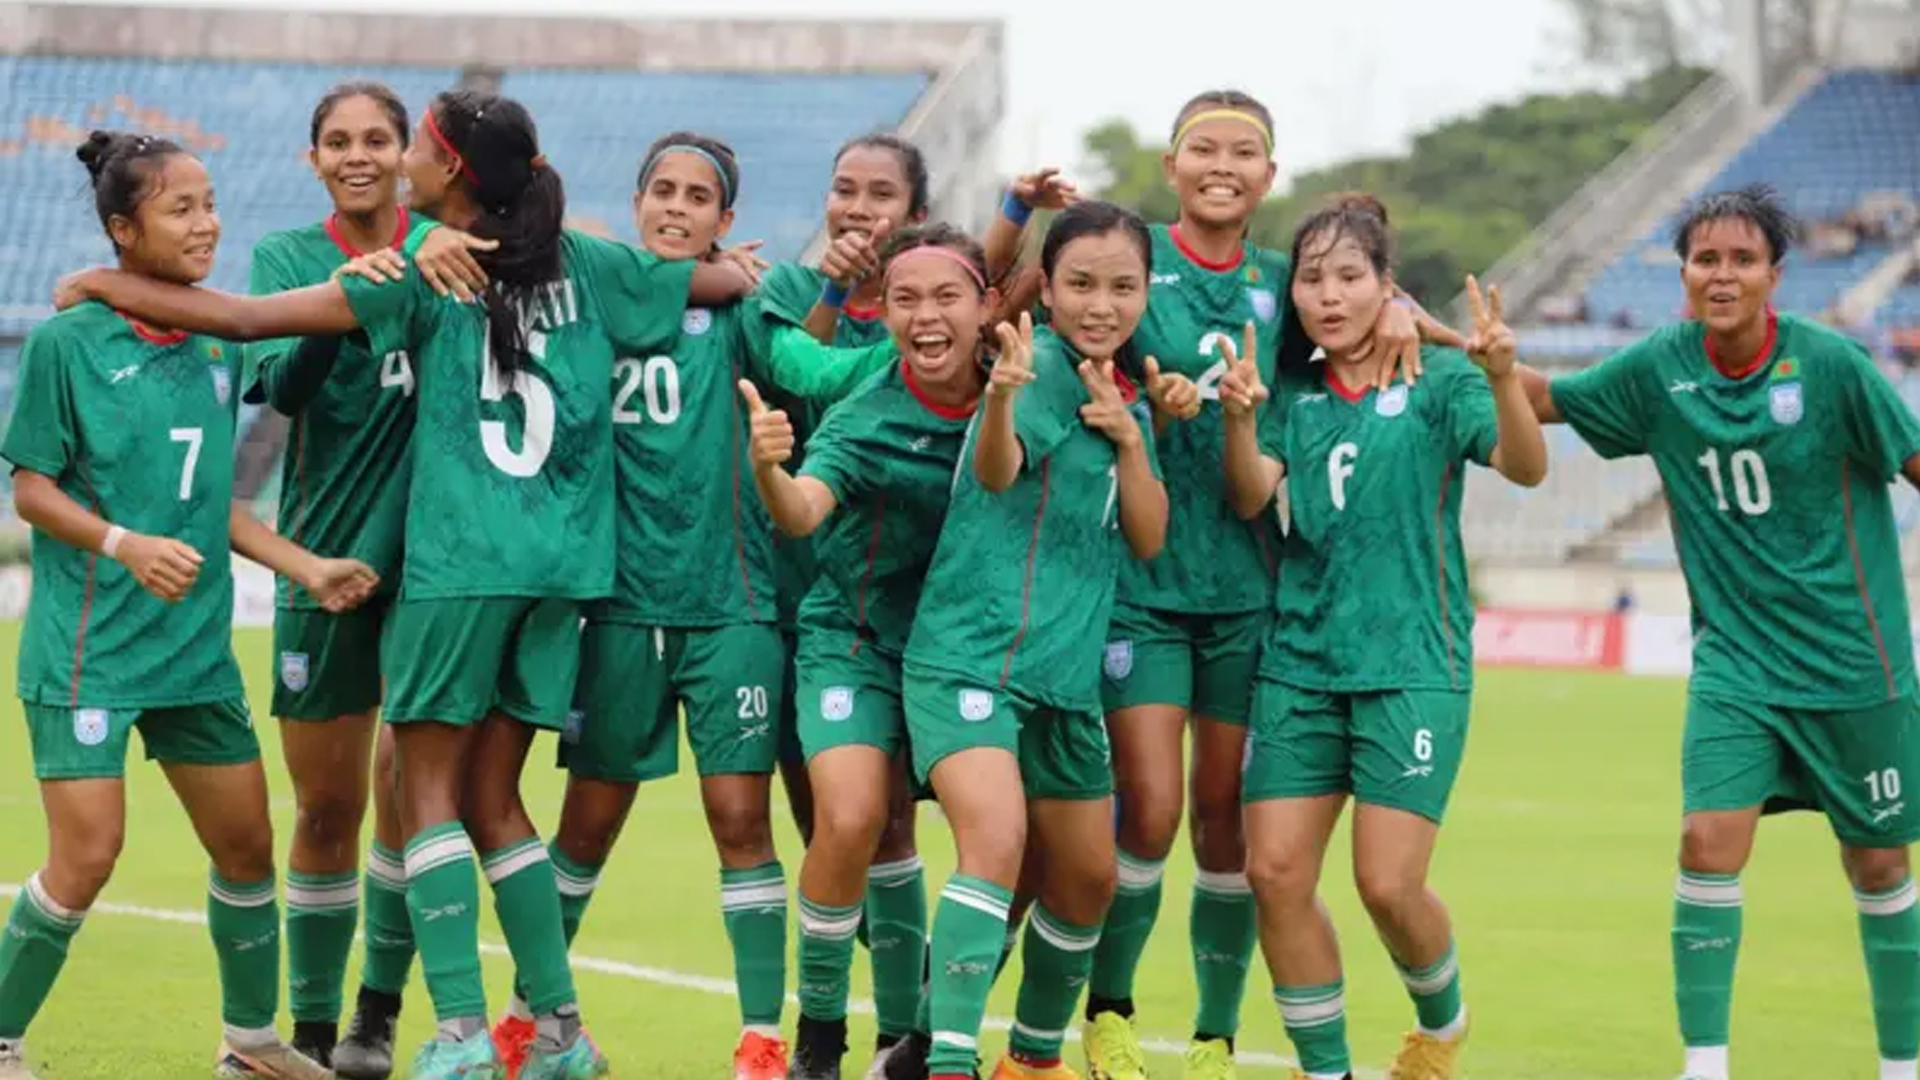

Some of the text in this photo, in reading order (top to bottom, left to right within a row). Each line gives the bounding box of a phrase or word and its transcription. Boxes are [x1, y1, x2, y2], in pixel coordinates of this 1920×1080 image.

[380, 350, 415, 397] 4
[480, 318, 555, 478] 5
[612, 355, 681, 425] 20
[1197, 331, 1237, 400] 2
[169, 427, 203, 500] 7
[1698, 447, 1771, 515] 10
[736, 685, 768, 719] 20
[1414, 728, 1433, 761] 6
[1864, 768, 1901, 802] 10
